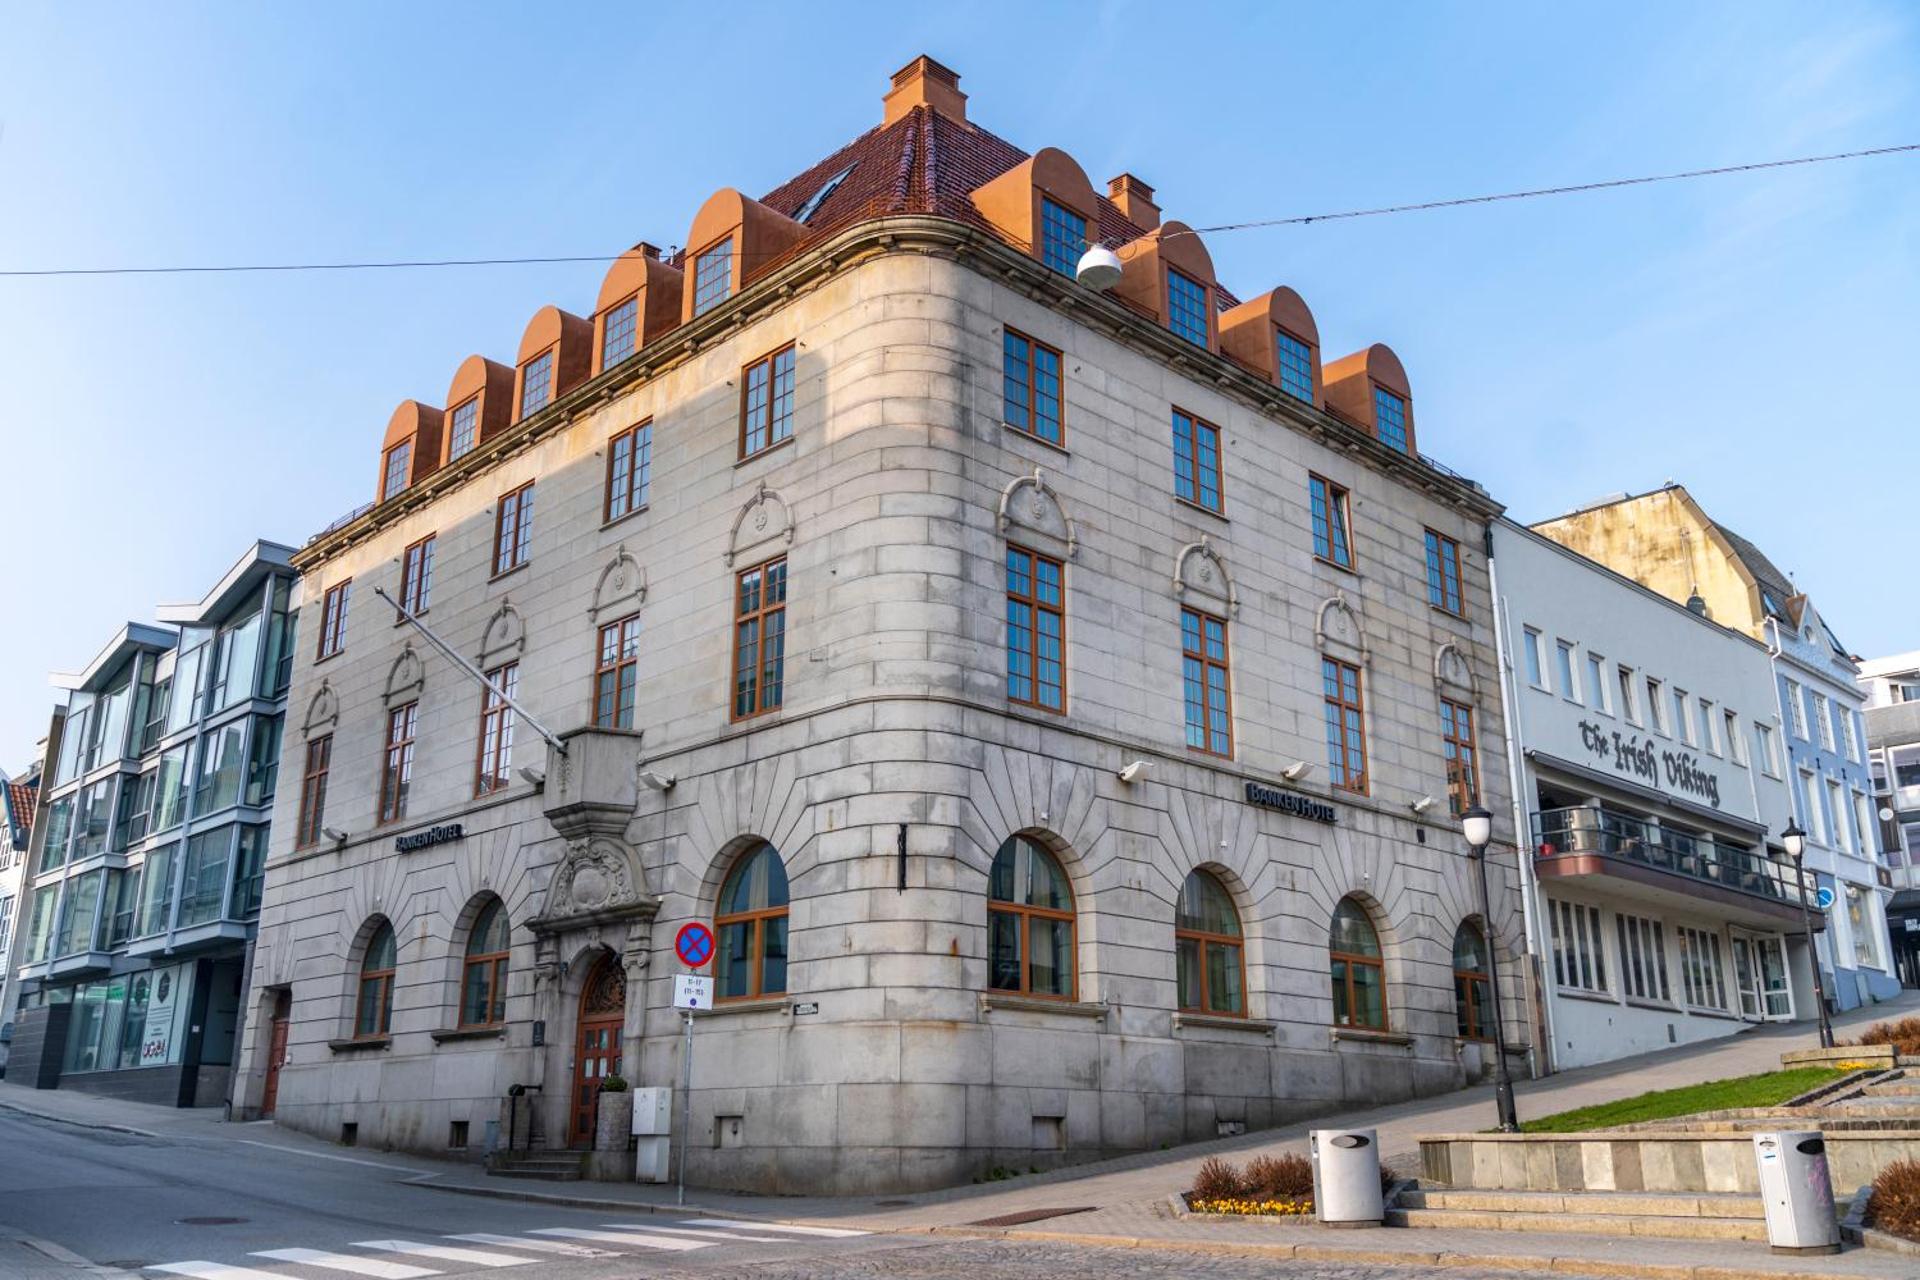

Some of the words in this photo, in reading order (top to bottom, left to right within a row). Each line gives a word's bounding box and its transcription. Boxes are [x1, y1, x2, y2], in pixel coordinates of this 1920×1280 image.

[1578, 719, 1609, 758] The
[1612, 731, 1658, 787] Irish
[1662, 749, 1720, 808] Viking
